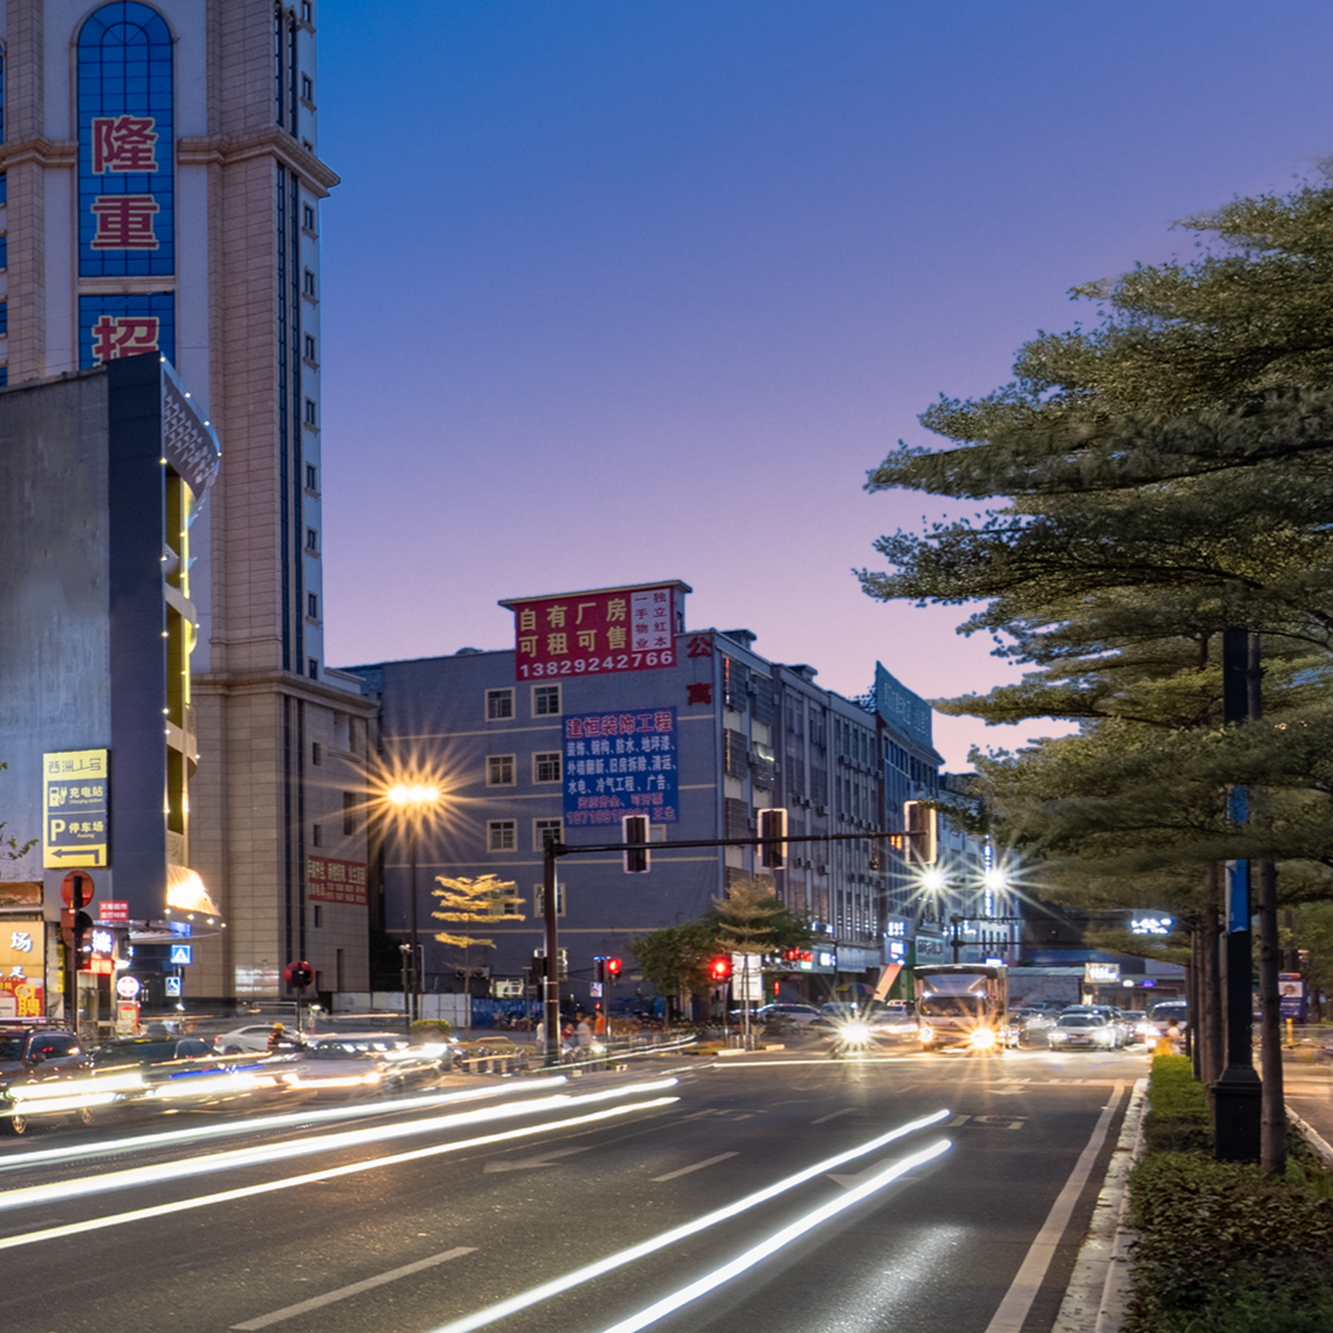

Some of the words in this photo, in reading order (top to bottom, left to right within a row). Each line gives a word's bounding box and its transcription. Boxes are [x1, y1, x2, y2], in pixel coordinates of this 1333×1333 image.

[520, 597, 627, 632] 自有厂房
[634, 595, 649, 649] 一手物业
[652, 591, 667, 647] 独立红本
[518, 625, 627, 658] 可租可售
[520, 650, 674, 678] 13829242766
[686, 636, 713, 707] 公寓
[566, 711, 673, 739] 建恒装饰工程
[69, 785, 104, 799] 充电站
[51, 819, 66, 842] P
[69, 820, 104, 834] 停车场
